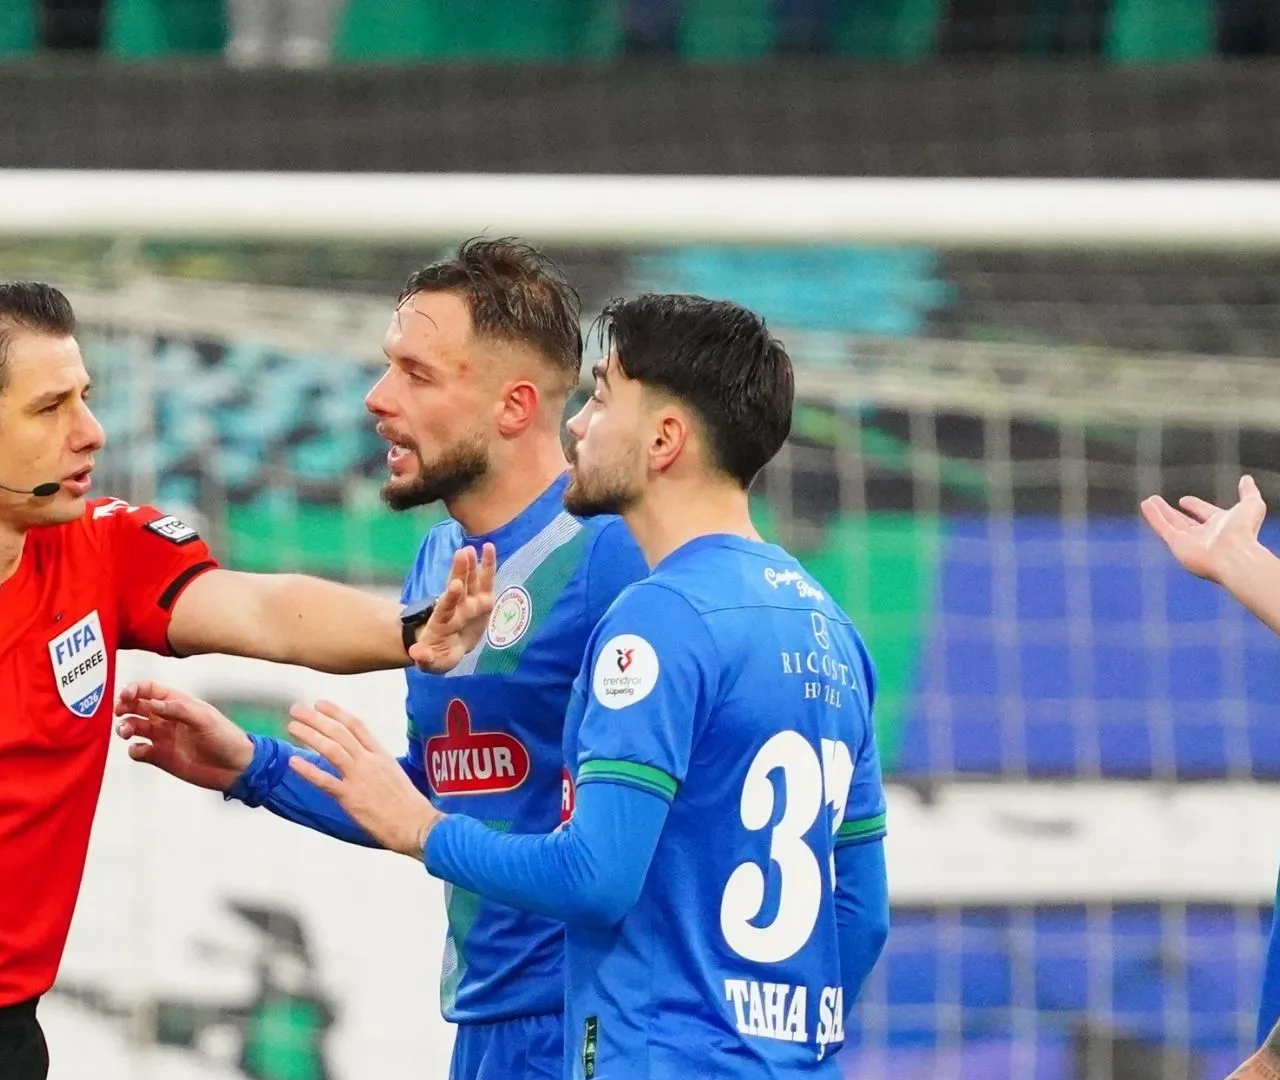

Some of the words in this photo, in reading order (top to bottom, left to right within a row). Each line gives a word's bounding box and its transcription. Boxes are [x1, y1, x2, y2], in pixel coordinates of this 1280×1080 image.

[55, 623, 97, 666] FIFA
[61, 650, 104, 688] REFEREE
[79, 692, 100, 713] 2026
[431, 746, 516, 788] ÇAYKUR
[724, 979, 808, 1043] TAHA
